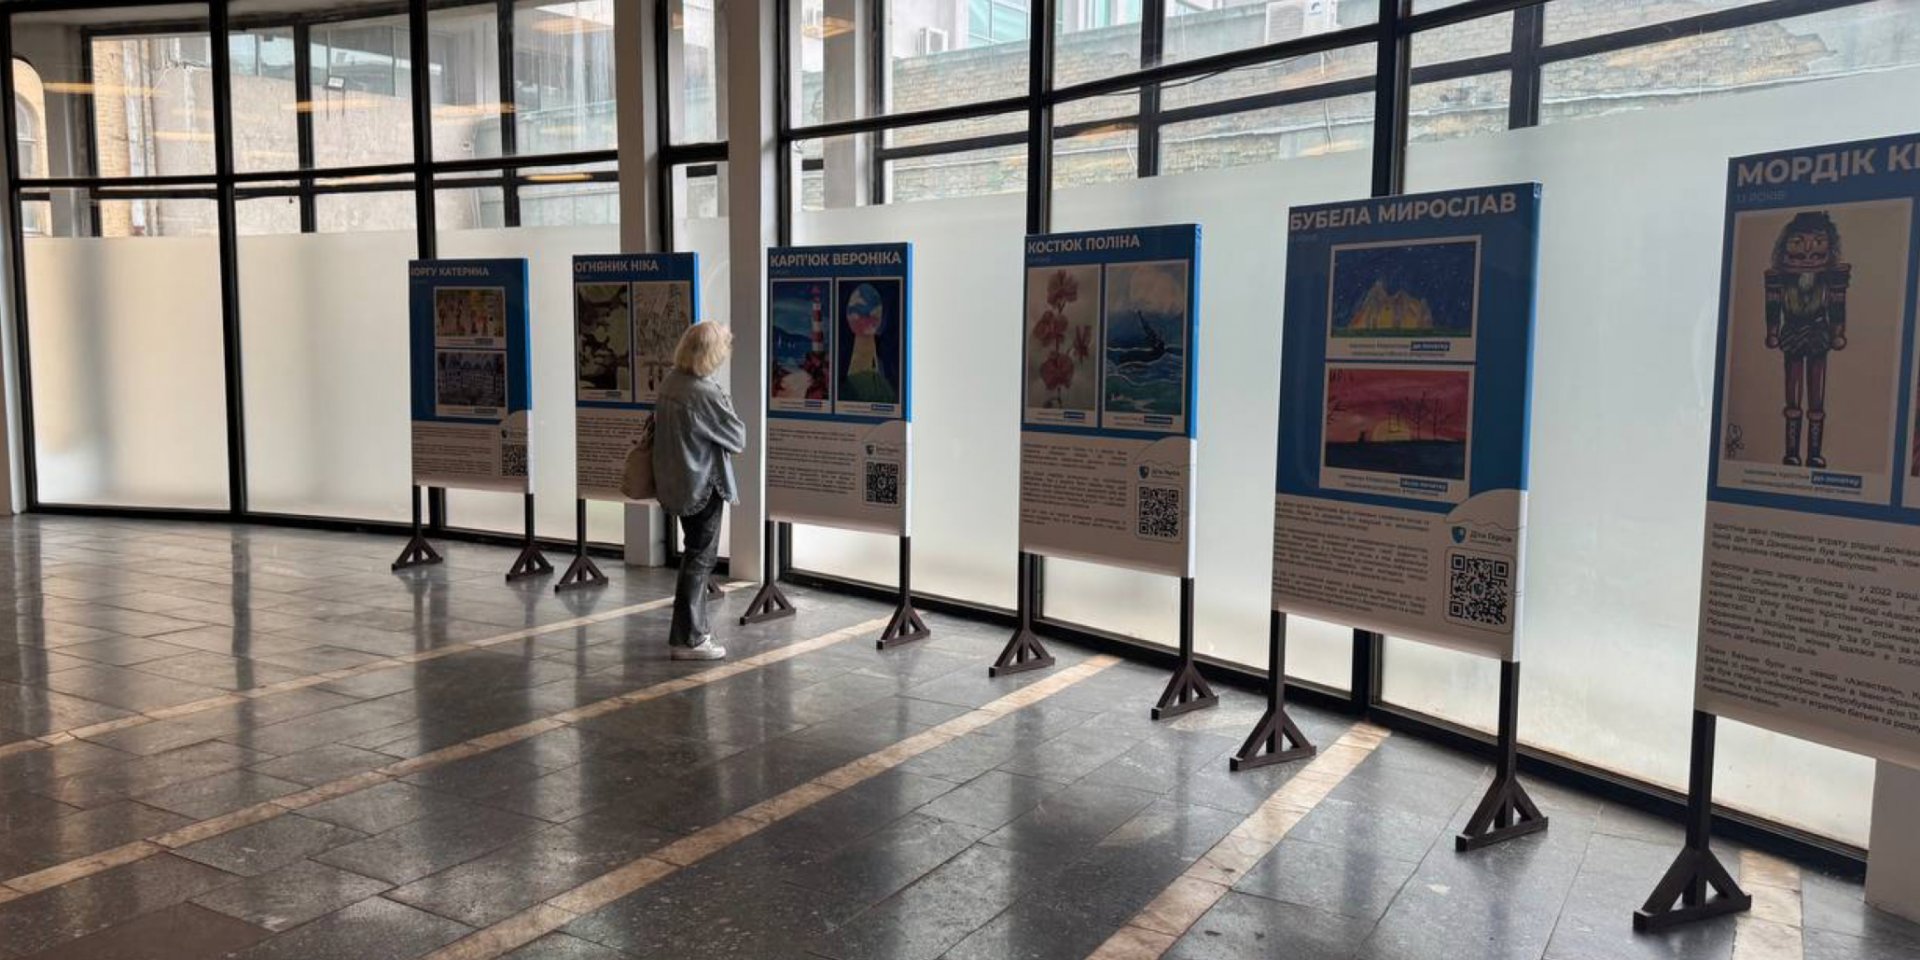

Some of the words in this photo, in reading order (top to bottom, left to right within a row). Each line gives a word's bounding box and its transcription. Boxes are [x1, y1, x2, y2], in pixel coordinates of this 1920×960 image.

[1737, 147, 1876, 187] МОРДІК
[1290, 206, 1371, 231] БУБЕЛА
[1378, 192, 1516, 223] МИРОСЛАВ
[1027, 238, 1082, 253] КОСТЮК
[1086, 234, 1140, 250] ПОЛІНА
[630, 259, 659, 271] НІКА
[770, 253, 829, 267] КАРП'ЮК
[833, 251, 902, 265] ВЕРОНІКА
[439, 266, 490, 276] КАТЕРИНА
[1869, 585, 1891, 596] 2022
